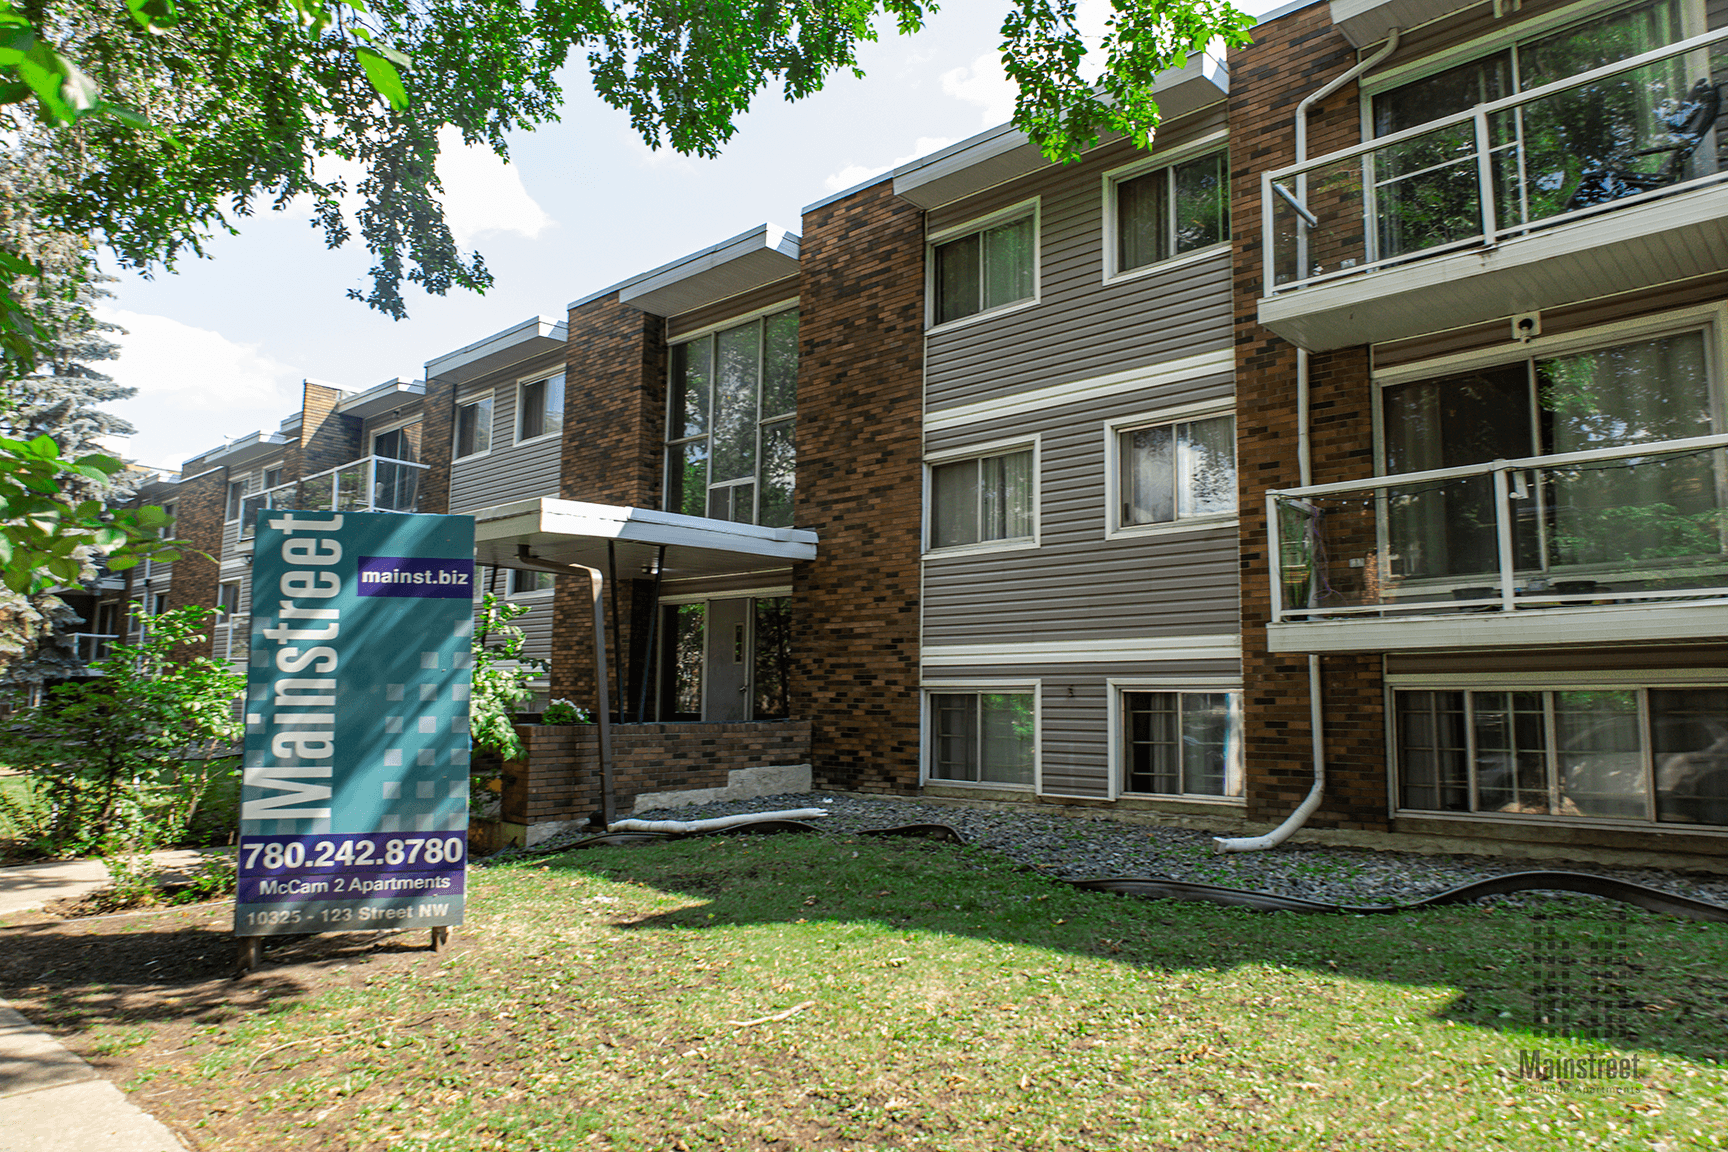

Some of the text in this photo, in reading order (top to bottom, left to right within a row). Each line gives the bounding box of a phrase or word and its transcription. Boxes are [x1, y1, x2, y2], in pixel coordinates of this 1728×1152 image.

[361, 568, 469, 585] mainst.biz
[242, 513, 344, 820] Mainstreet
[242, 837, 464, 870] 780.242.8780
[259, 875, 451, 895] McCam 2 Apartments
[247, 909, 302, 926] 10325
[321, 908, 353, 922] 123
[358, 905, 414, 921] Street
[418, 903, 449, 918] NW
